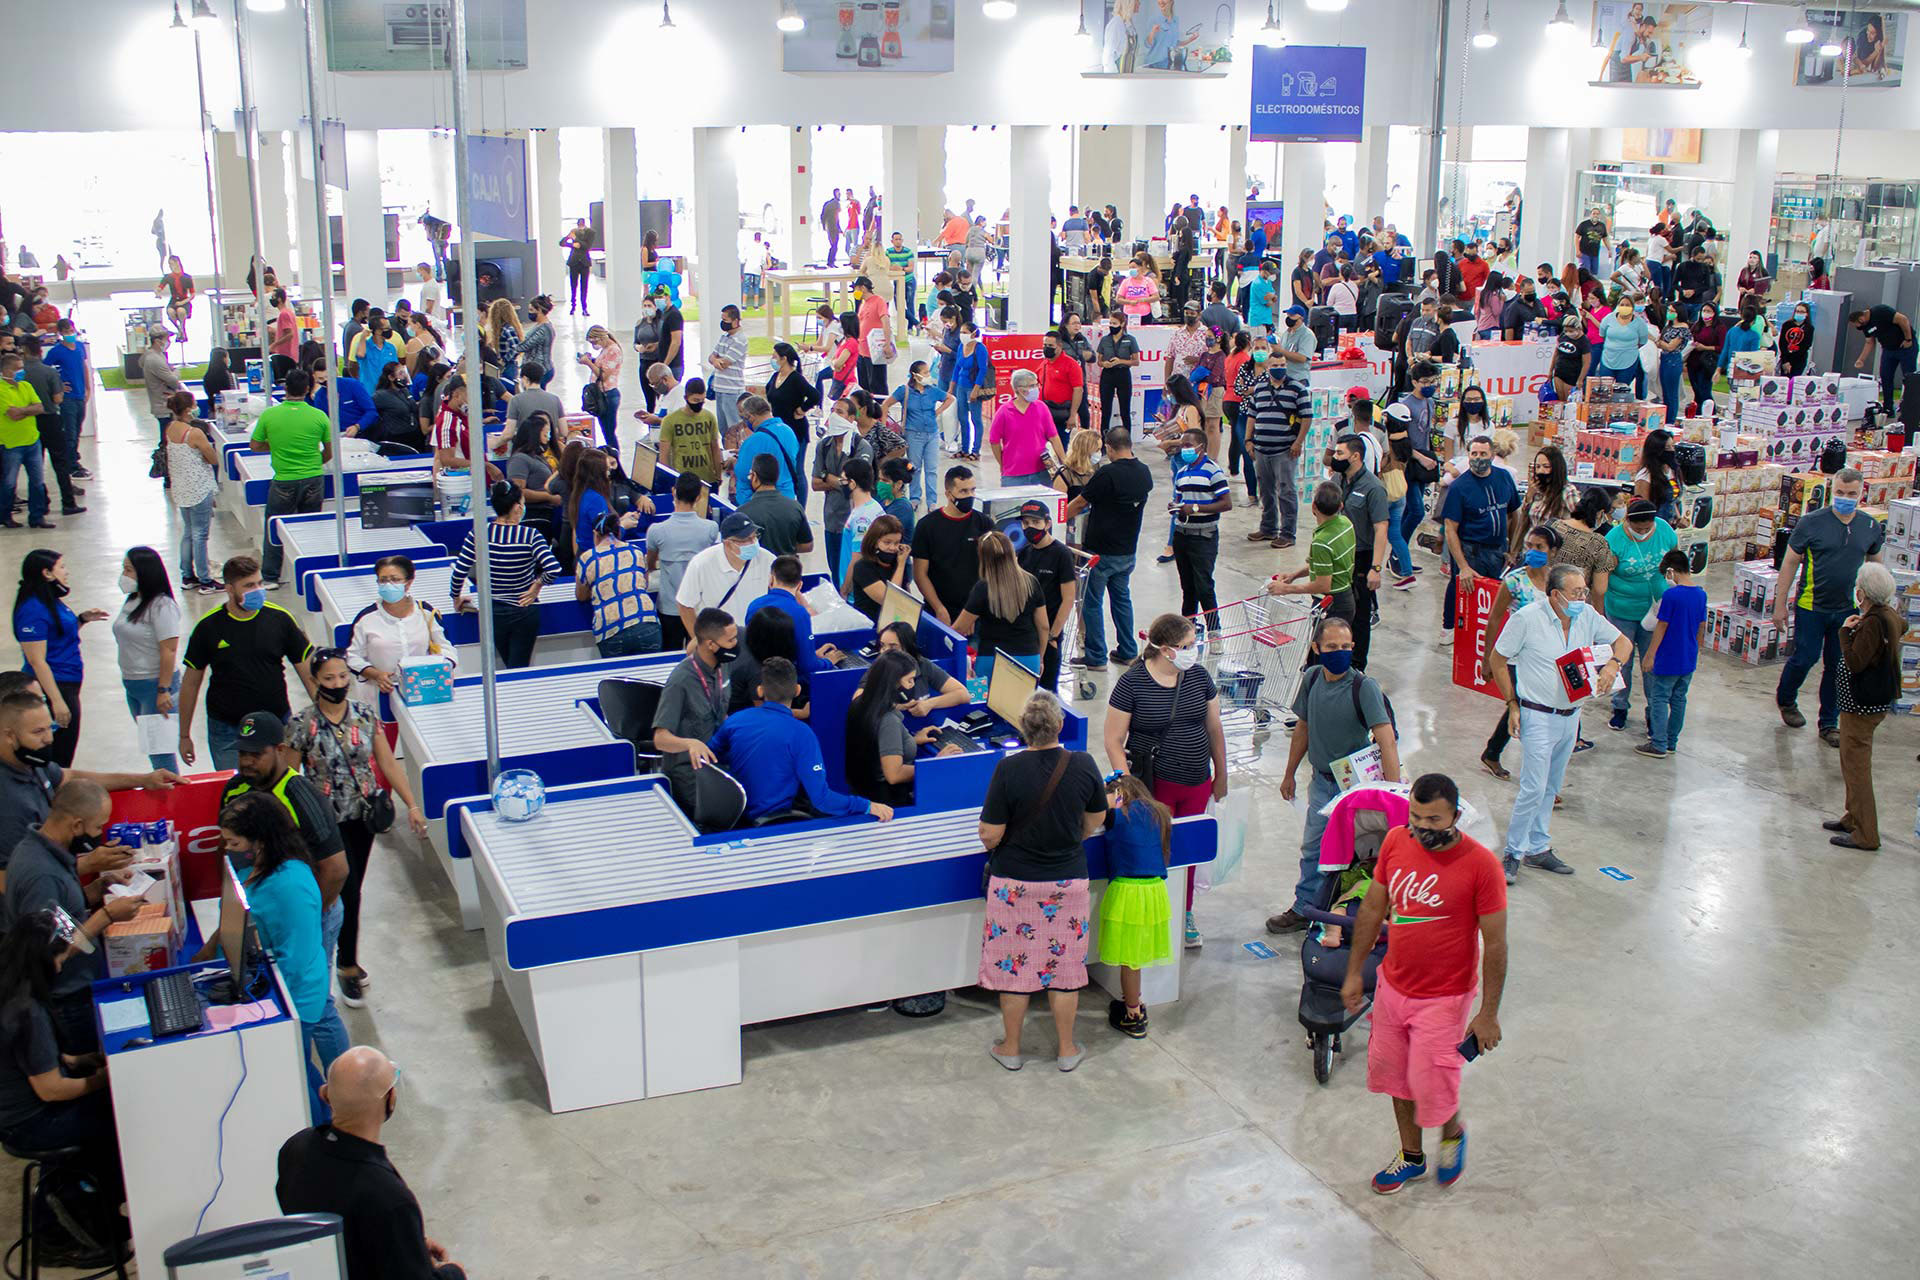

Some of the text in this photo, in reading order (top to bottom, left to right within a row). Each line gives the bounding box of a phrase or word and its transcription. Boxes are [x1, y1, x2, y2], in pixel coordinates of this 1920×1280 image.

[1255, 103, 1360, 115] ELECTRODOMÉSTICOS
[472, 170, 513, 205] CAJA 1
[674, 421, 713, 436] BORN
[682, 454, 708, 468] WIN
[1388, 868, 1444, 911] Nike
